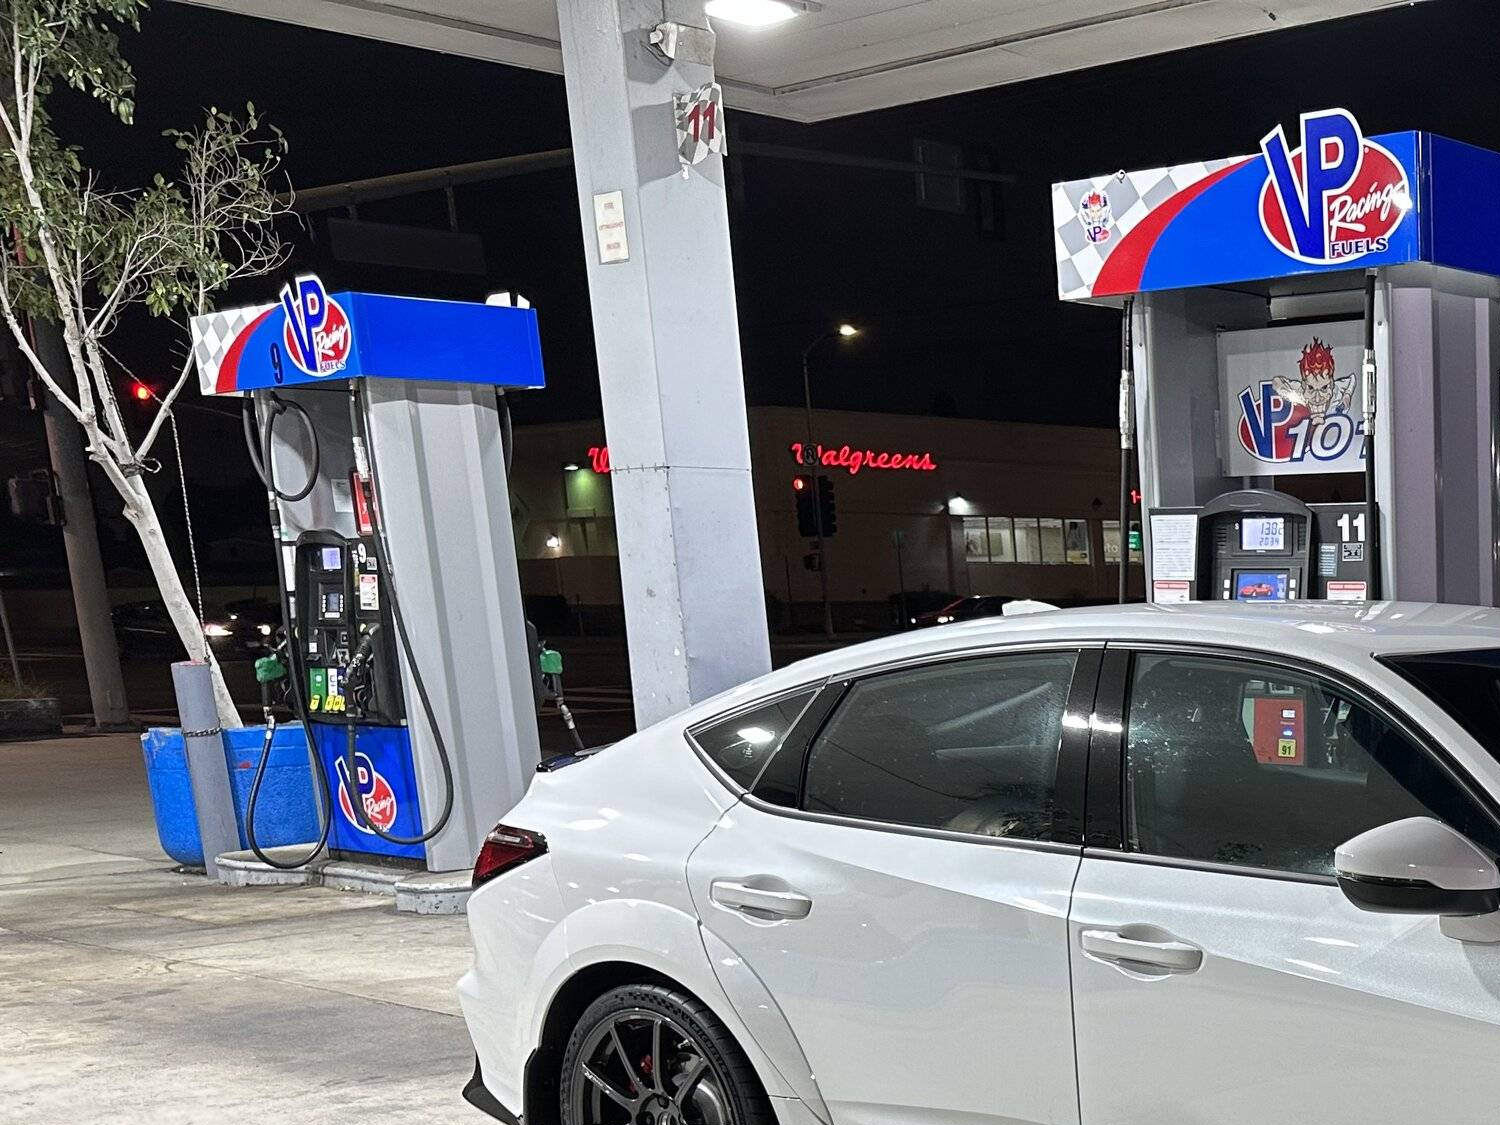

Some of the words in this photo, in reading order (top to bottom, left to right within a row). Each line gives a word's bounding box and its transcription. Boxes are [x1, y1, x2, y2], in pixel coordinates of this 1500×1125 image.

[688, 101, 715, 142] 11
[1261, 109, 1362, 263] VP
[1329, 183, 1405, 231] Racing
[1330, 237, 1388, 257] FUELS
[280, 276, 328, 374] VP
[270, 342, 283, 384] 9
[1238, 380, 1293, 460] VP
[1337, 513, 1365, 541] 11
[358, 543, 367, 563] 9
[1281, 745, 1291, 755] 91
